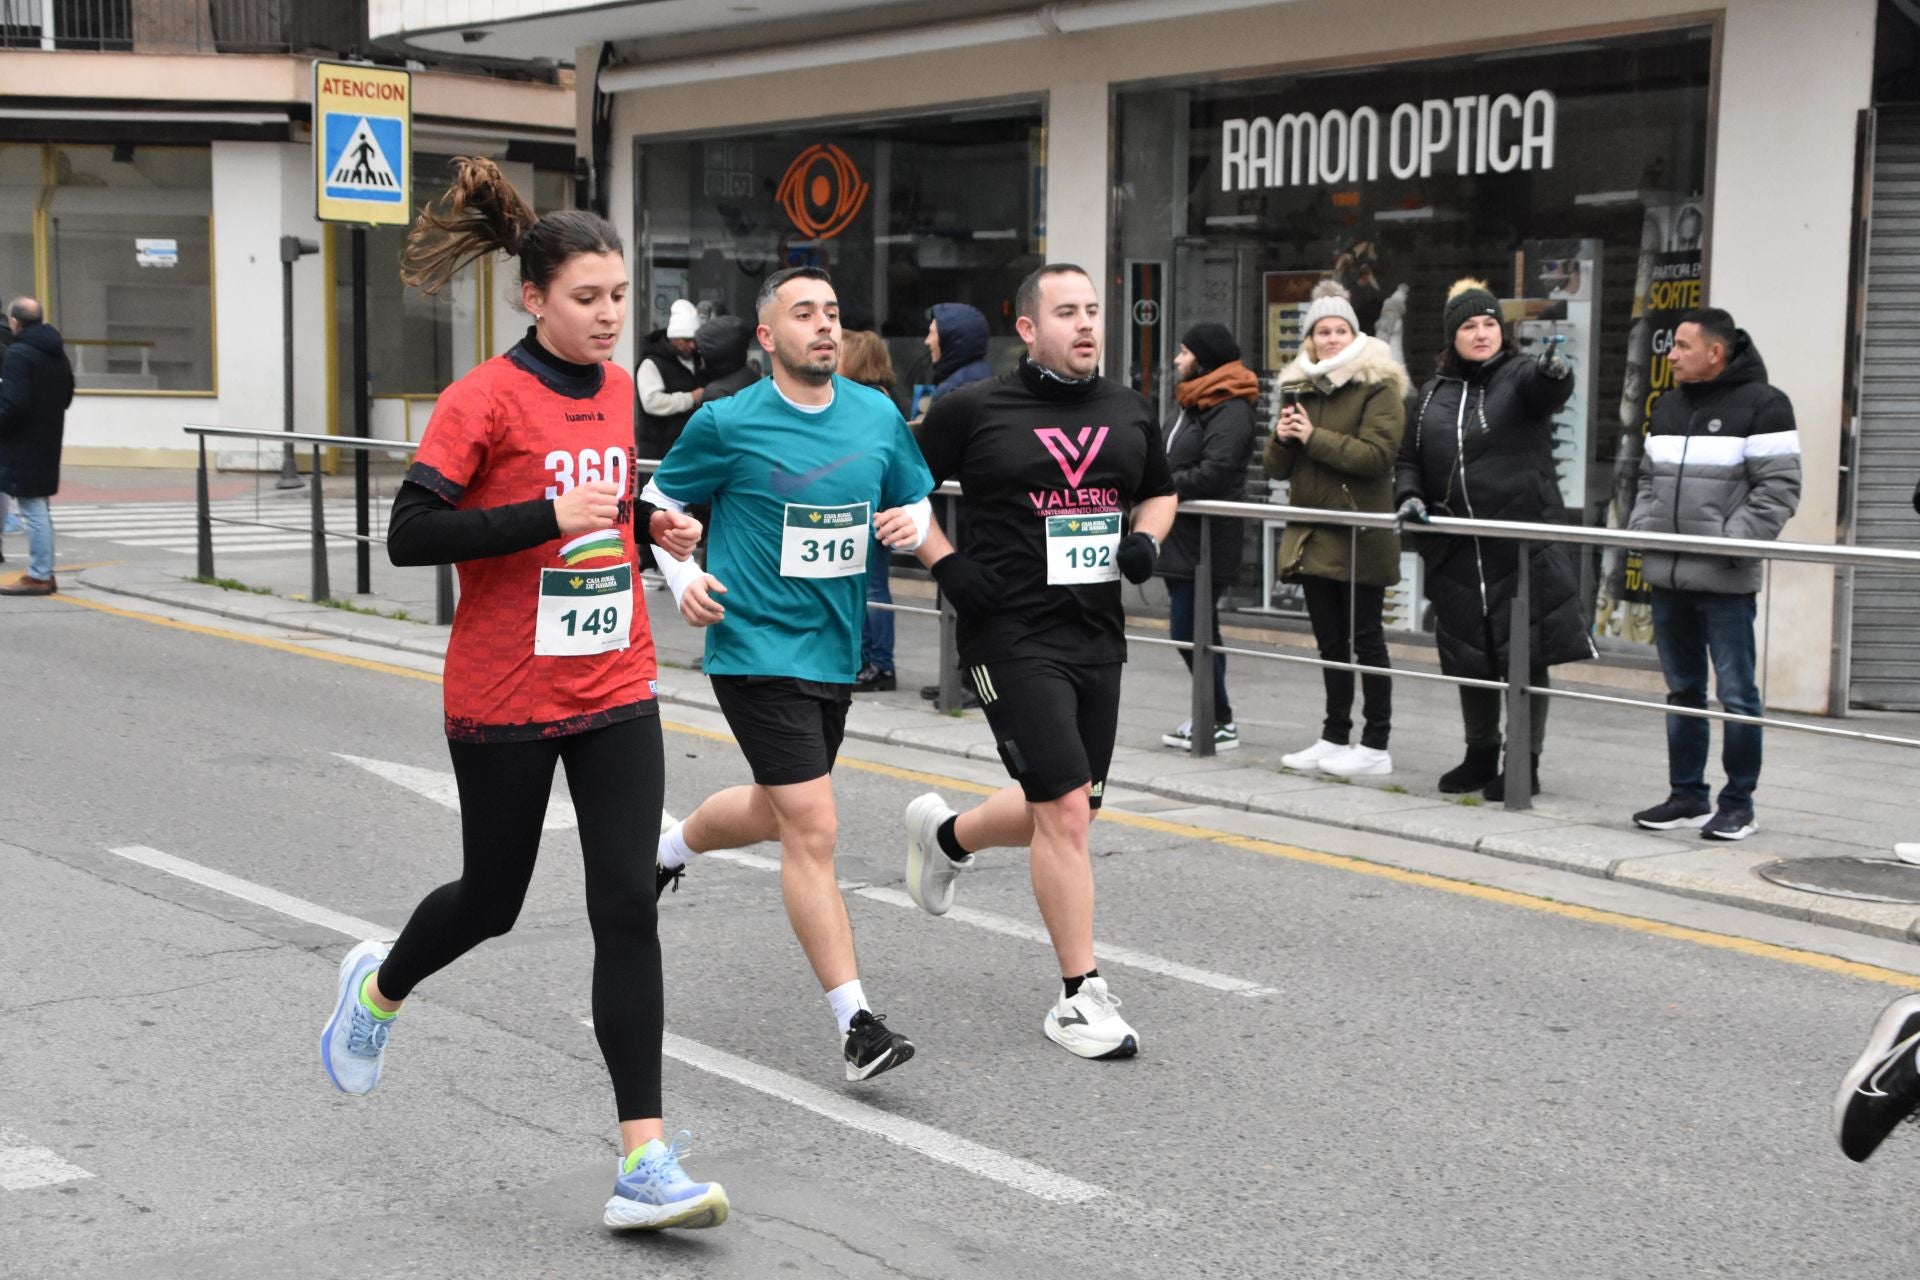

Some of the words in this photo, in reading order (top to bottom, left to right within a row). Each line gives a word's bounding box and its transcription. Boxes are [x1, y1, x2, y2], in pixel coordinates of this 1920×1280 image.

[322, 77, 405, 101] ATENCION
[1221, 105, 1380, 191] RAMON
[1389, 89, 1557, 180] OPTICA
[565, 412, 595, 422] luanvi
[545, 446, 627, 500] 360
[1028, 488, 1118, 509] VALERIO
[800, 537, 855, 563] 316
[1065, 545, 1110, 569] 192
[560, 606, 618, 637] 149
